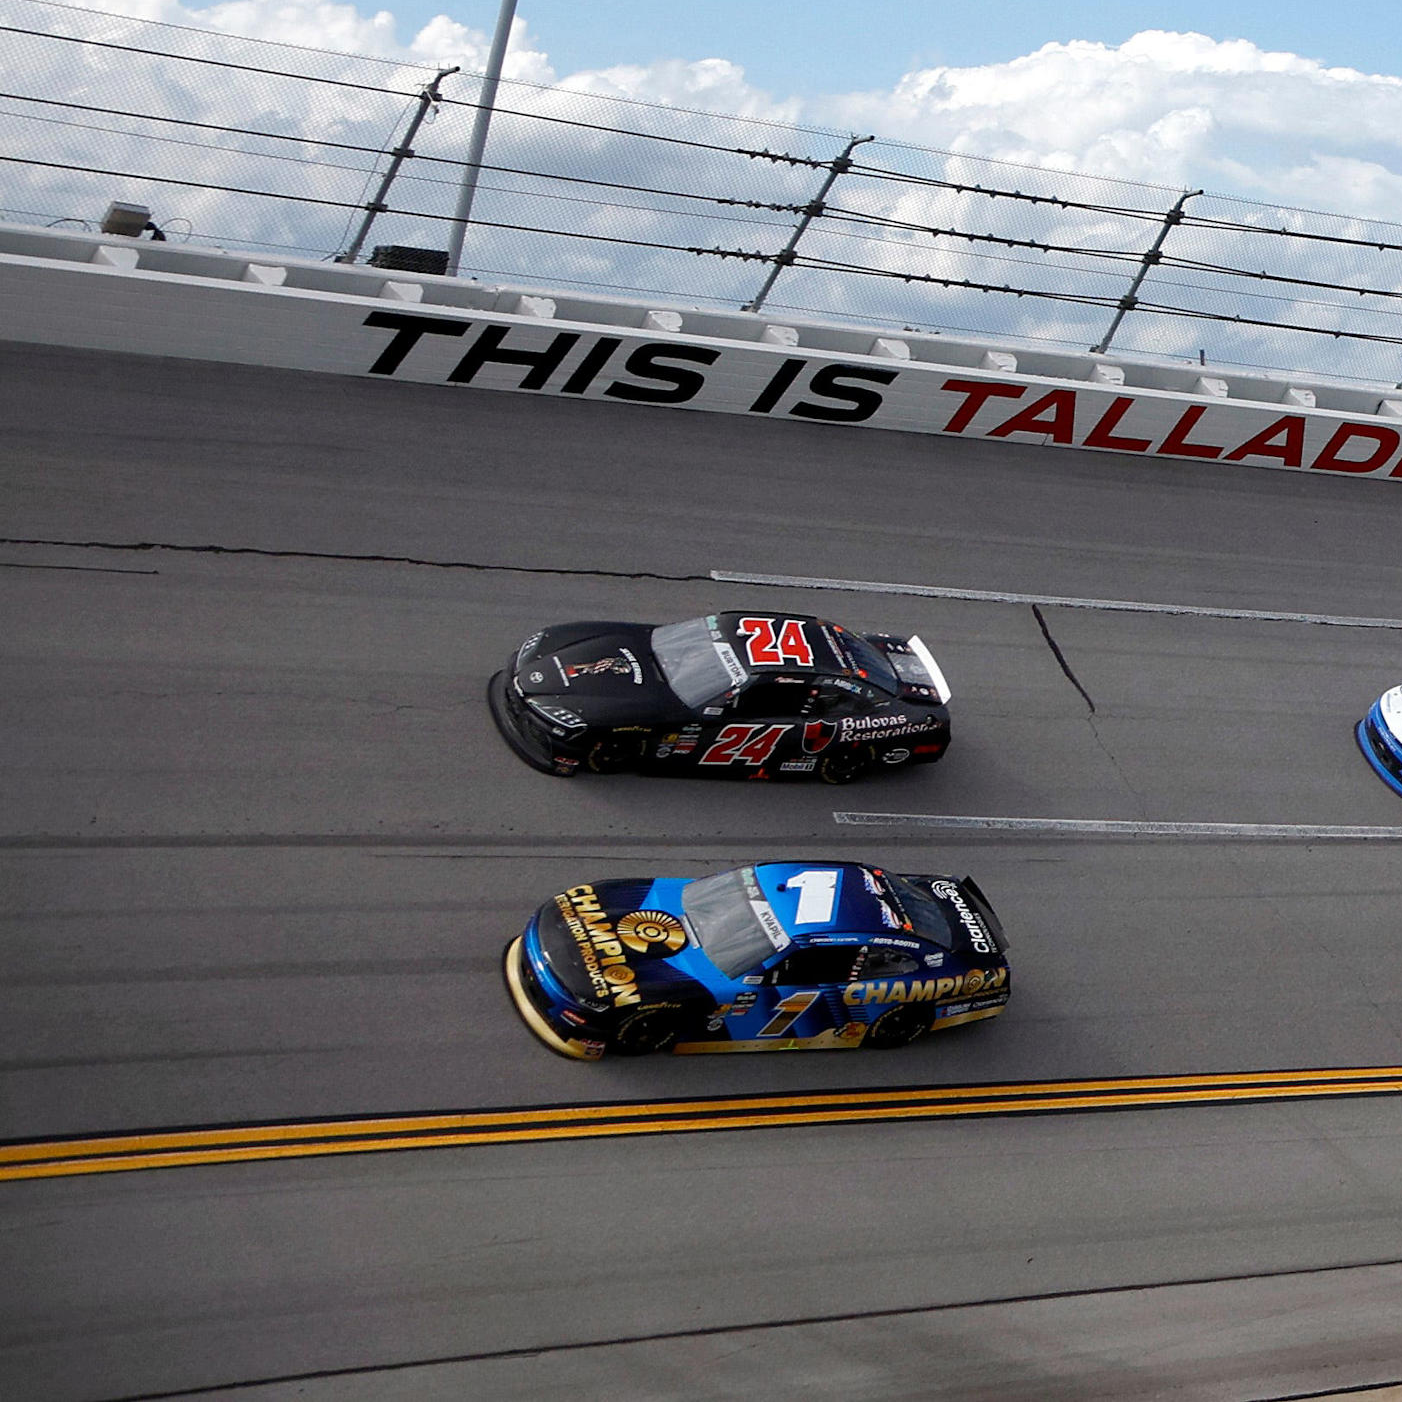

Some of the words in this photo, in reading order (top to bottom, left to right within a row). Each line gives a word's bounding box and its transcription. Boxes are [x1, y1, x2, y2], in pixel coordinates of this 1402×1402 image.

[362, 311, 721, 404] THIS
[748, 359, 899, 423] IS
[721, 649, 742, 681] BURTON
[739, 617, 814, 667] 24
[698, 724, 796, 765] 24
[840, 714, 908, 731] Bulovas
[786, 870, 838, 926] 1
[945, 886, 990, 954] Clarience
[566, 884, 641, 1007] CHAMPION
[760, 910, 781, 941] KVAPIL
[578, 942, 610, 998] PRODUCTS
[843, 966, 1008, 1006] CHAMPION
[756, 991, 822, 1036] 1
